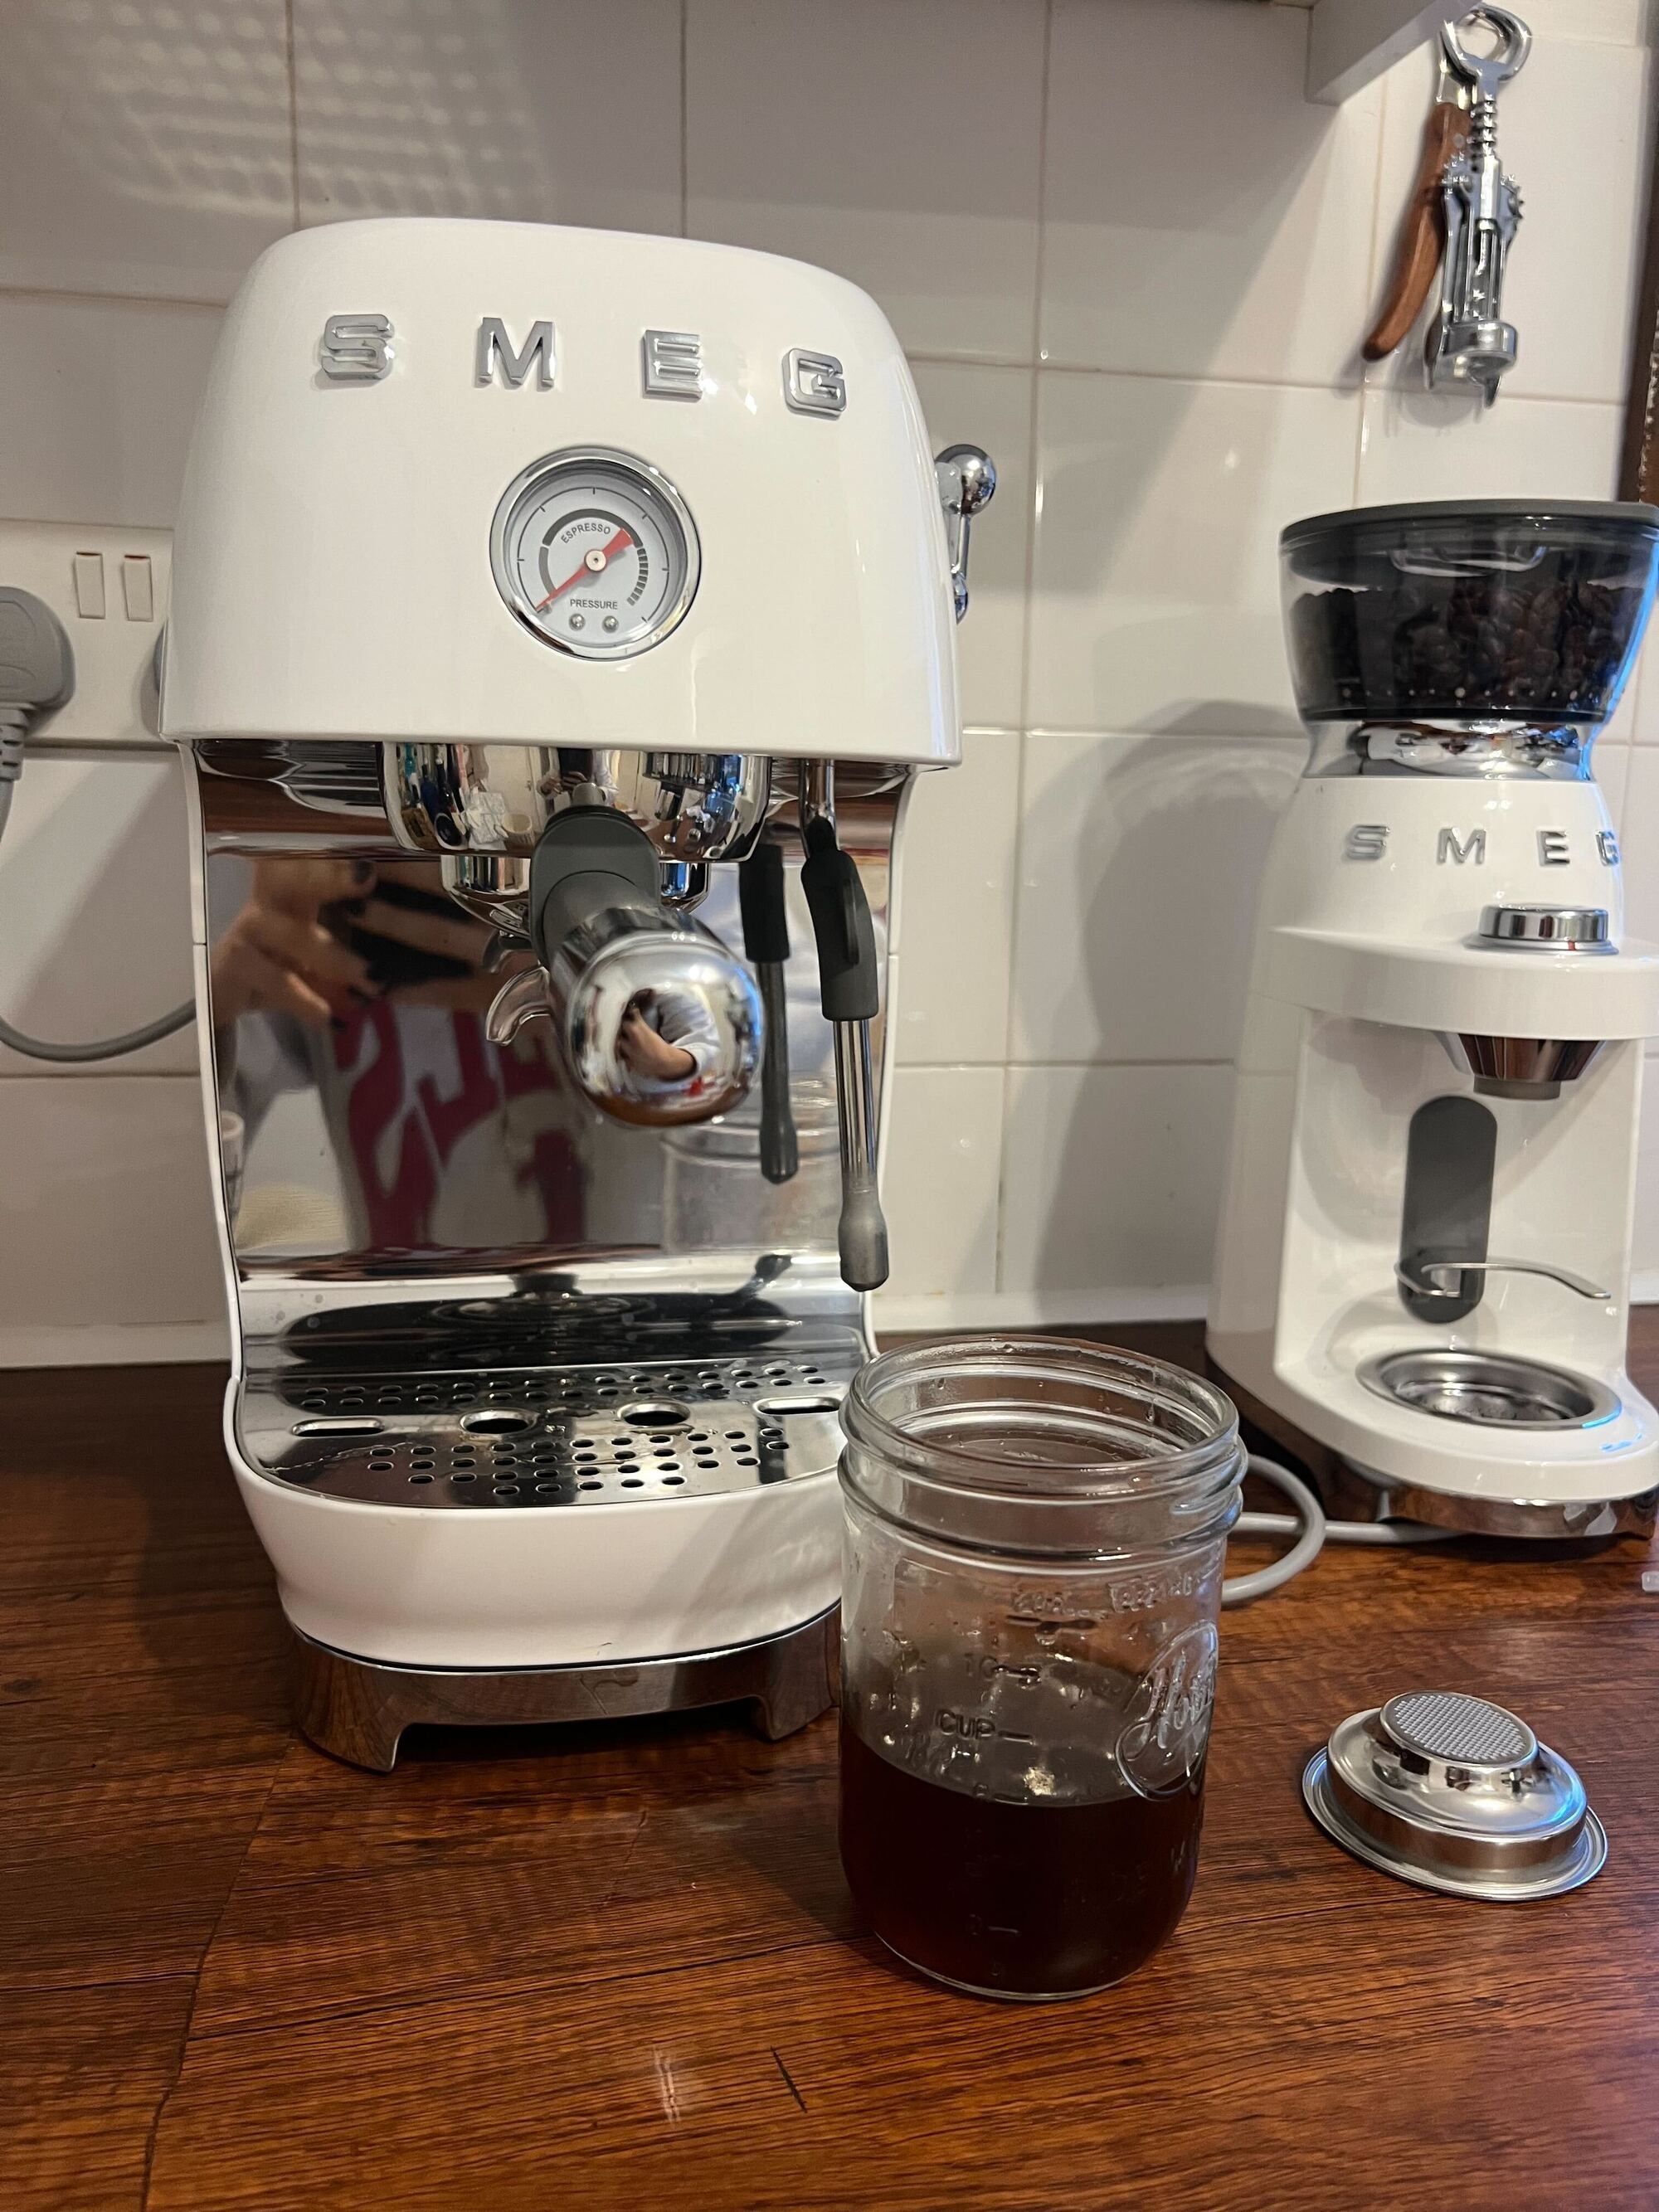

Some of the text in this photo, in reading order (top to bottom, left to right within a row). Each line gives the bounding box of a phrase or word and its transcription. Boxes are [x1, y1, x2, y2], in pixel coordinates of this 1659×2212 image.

[321, 313, 847, 421] SMEG
[561, 523, 611, 544] ESPRESSO
[570, 598, 618, 610] PRESSURE
[1346, 824, 1619, 867] SMEG
[937, 1709, 995, 1740] CUP
